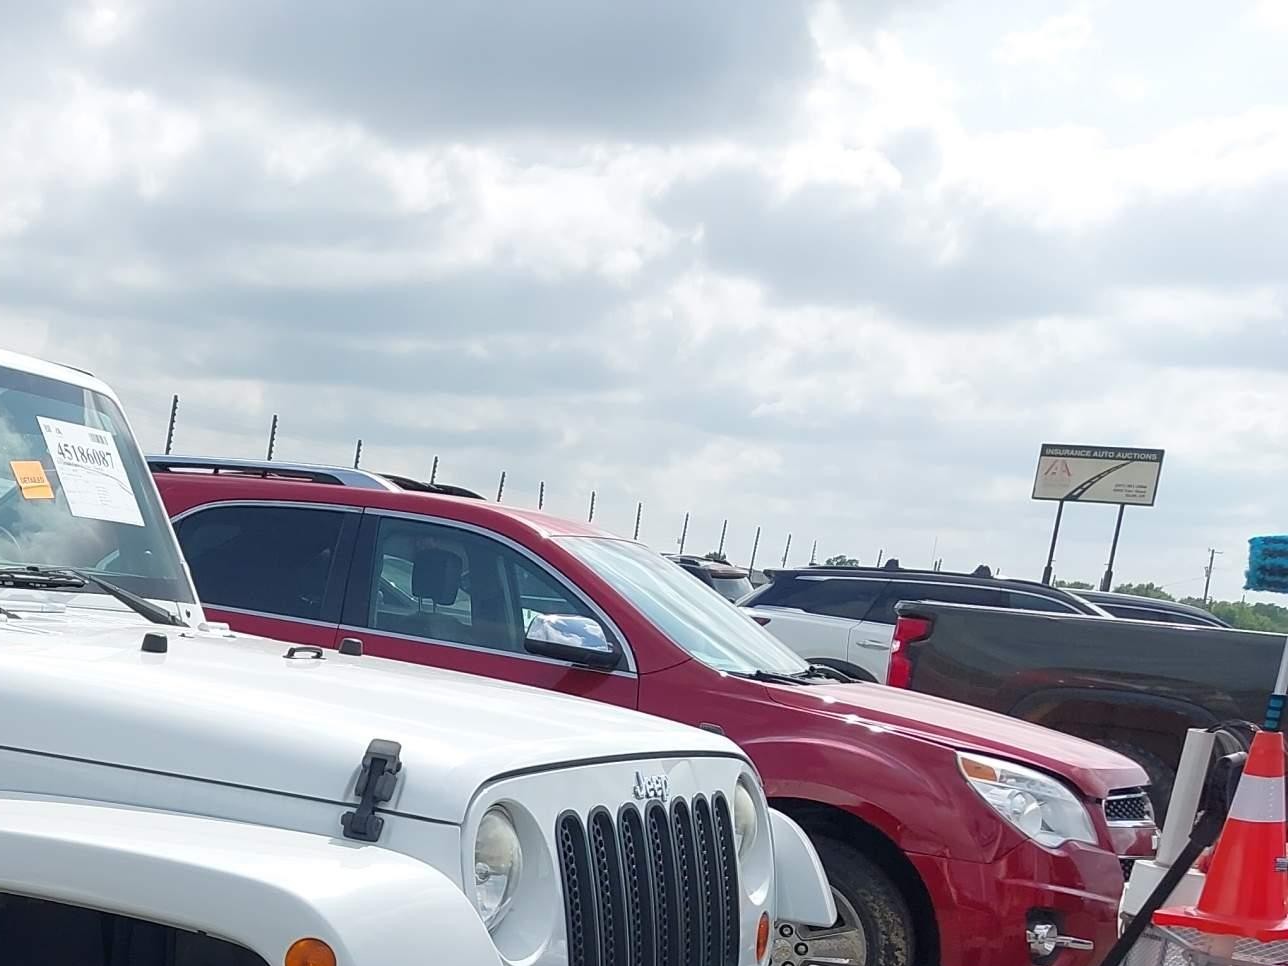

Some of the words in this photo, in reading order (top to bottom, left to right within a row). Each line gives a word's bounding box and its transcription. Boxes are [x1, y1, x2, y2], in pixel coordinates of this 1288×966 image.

[57, 442, 114, 469] 45186087
[1045, 448, 1091, 457] INSURANCE
[1116, 452, 1158, 461] AUCTIONS
[633, 770, 670, 803] Jeep
